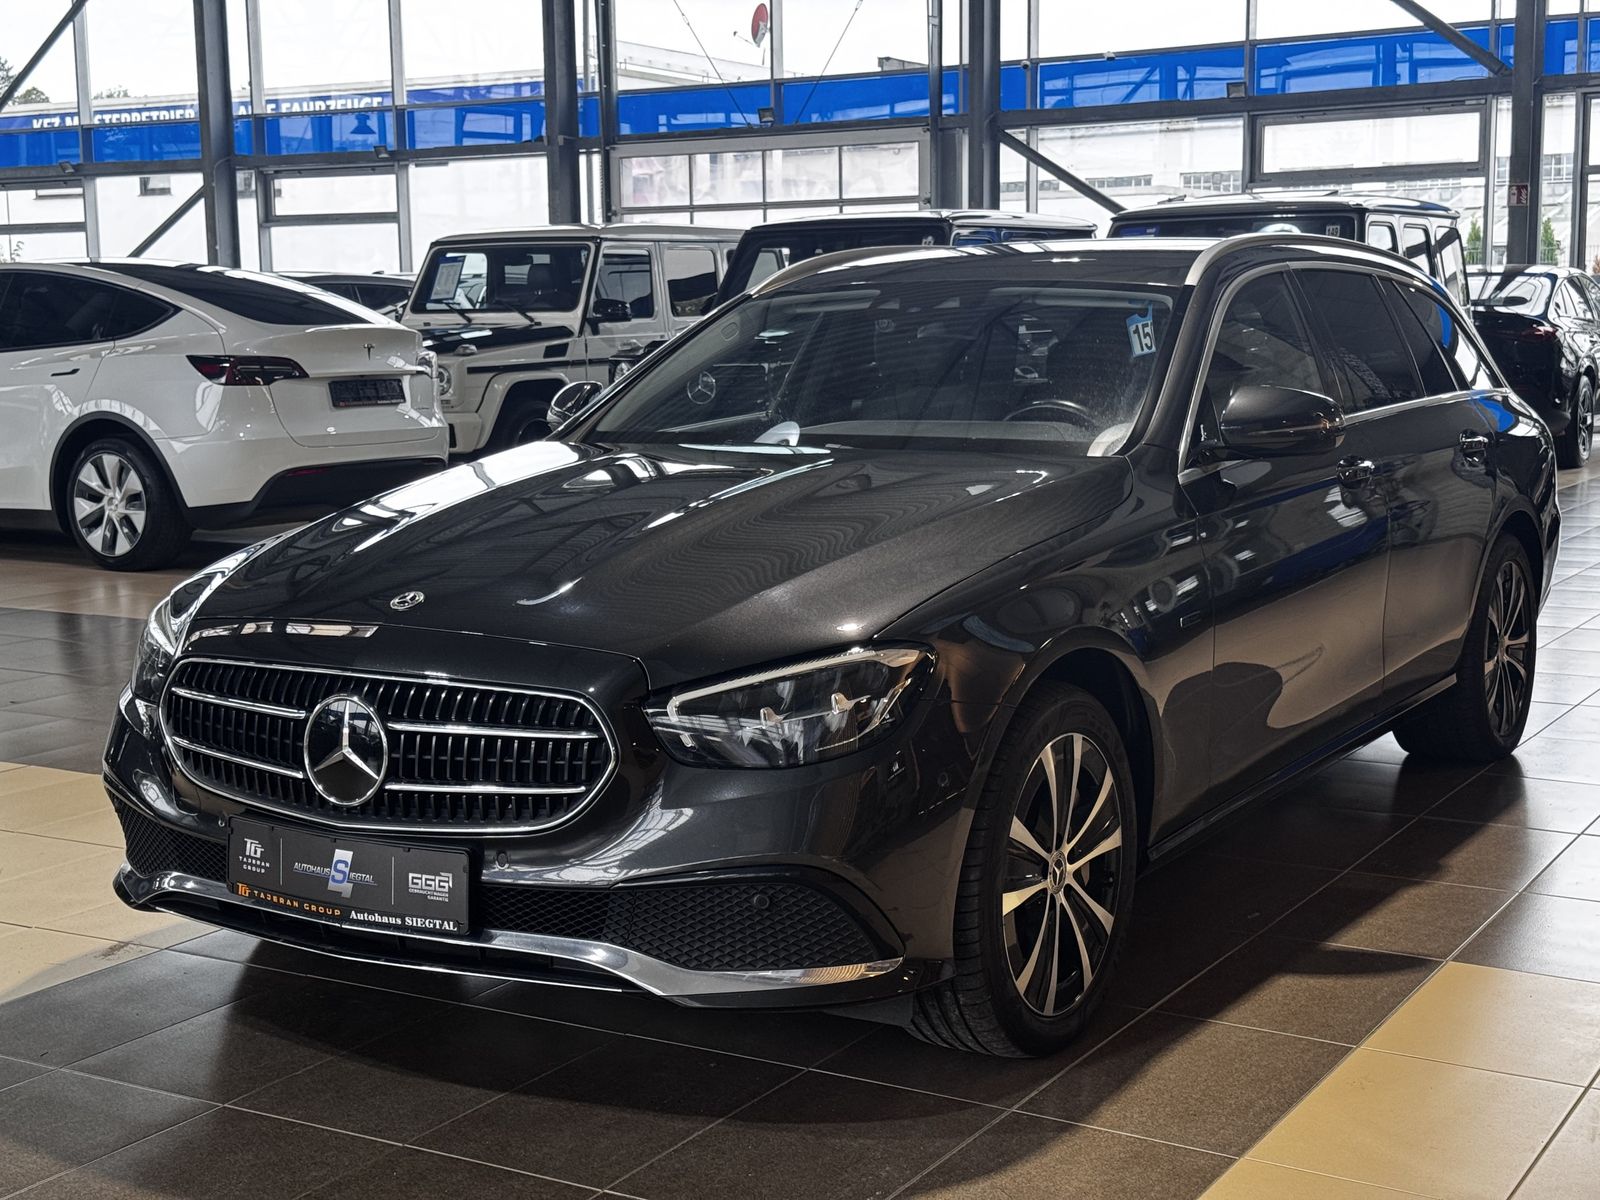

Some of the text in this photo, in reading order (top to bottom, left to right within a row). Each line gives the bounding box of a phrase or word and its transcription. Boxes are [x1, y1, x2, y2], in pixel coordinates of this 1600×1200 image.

[294, 862, 331, 876] AUTOHAUS
[254, 890, 299, 907] TAJERAN
[304, 903, 341, 916] GROUP
[349, 910, 458, 931] Autohaus SIEGTAL
